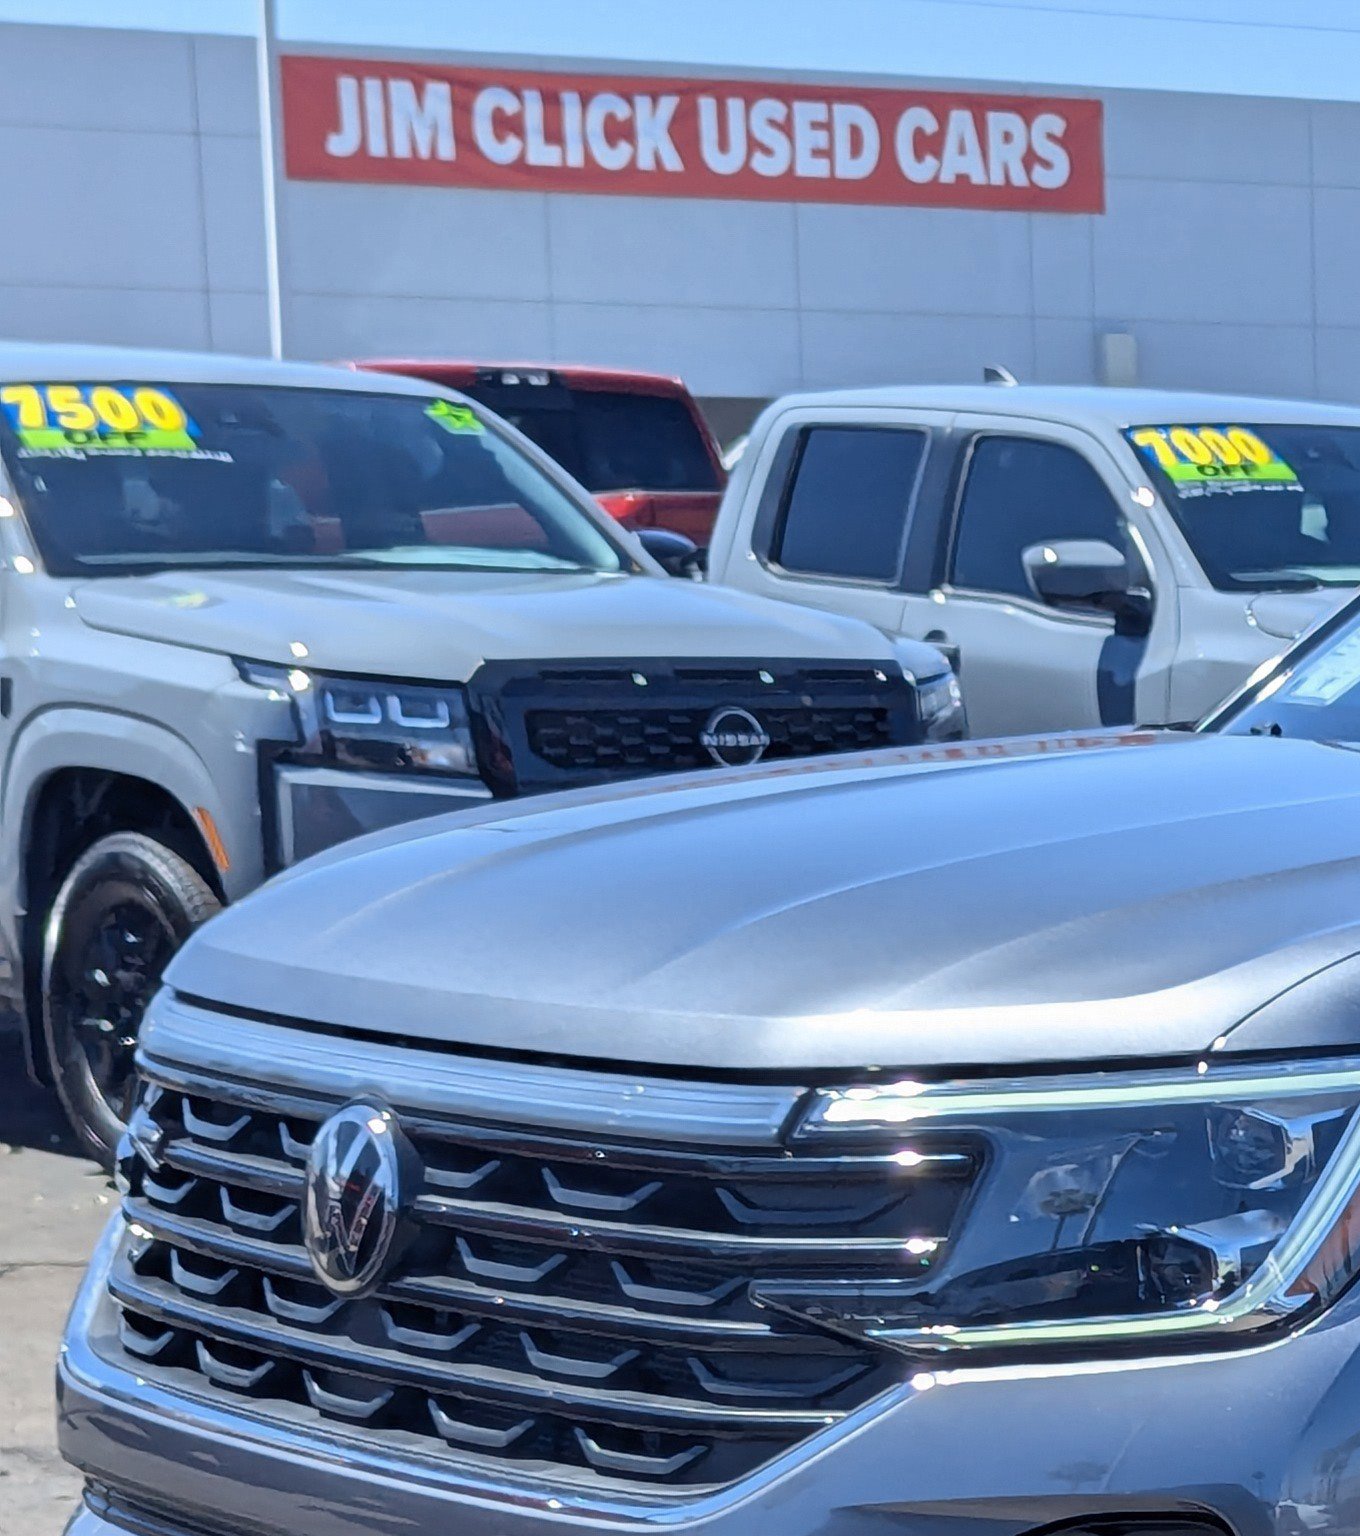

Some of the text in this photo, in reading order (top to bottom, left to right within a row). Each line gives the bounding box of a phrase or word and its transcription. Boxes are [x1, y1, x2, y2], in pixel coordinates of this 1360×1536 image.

[325, 76, 1072, 190] JIM CLICK USED CARS
[1, 384, 187, 431] 7500
[64, 429, 147, 445] OFF
[1133, 428, 1274, 467] 7000
[1196, 463, 1261, 478] OFF
